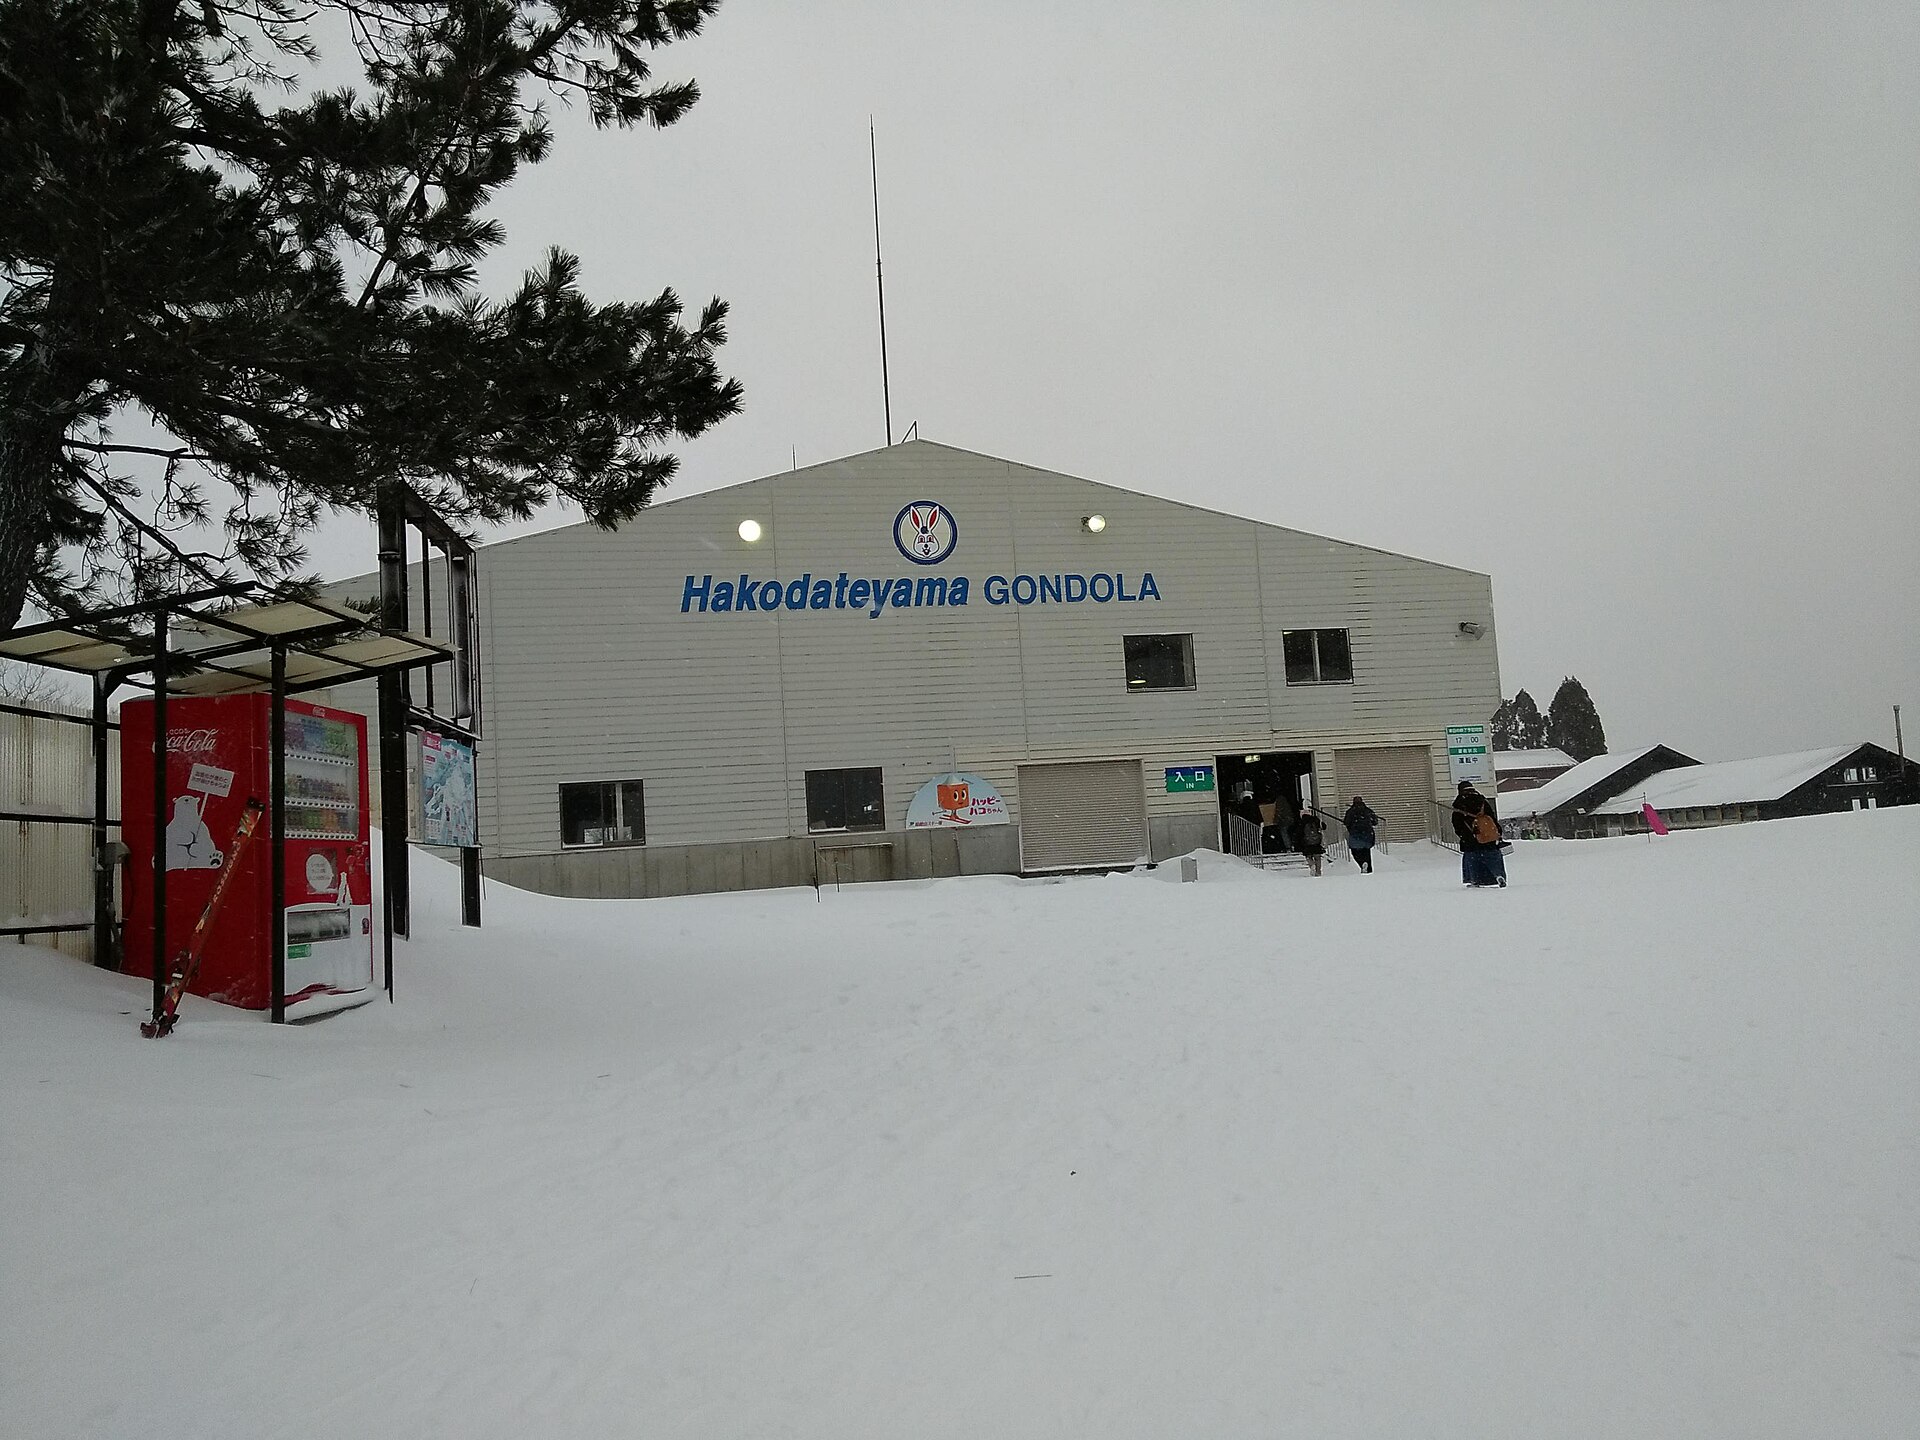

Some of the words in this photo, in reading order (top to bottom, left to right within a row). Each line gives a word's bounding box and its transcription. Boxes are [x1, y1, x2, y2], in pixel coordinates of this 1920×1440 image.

[681, 572, 970, 619] Hakodateyama
[983, 573, 1161, 606] GONDOLA
[1174, 771, 1205, 783] 入口
[971, 796, 1001, 806] ハッピー
[969, 807, 1003, 816] ハコちゃん
